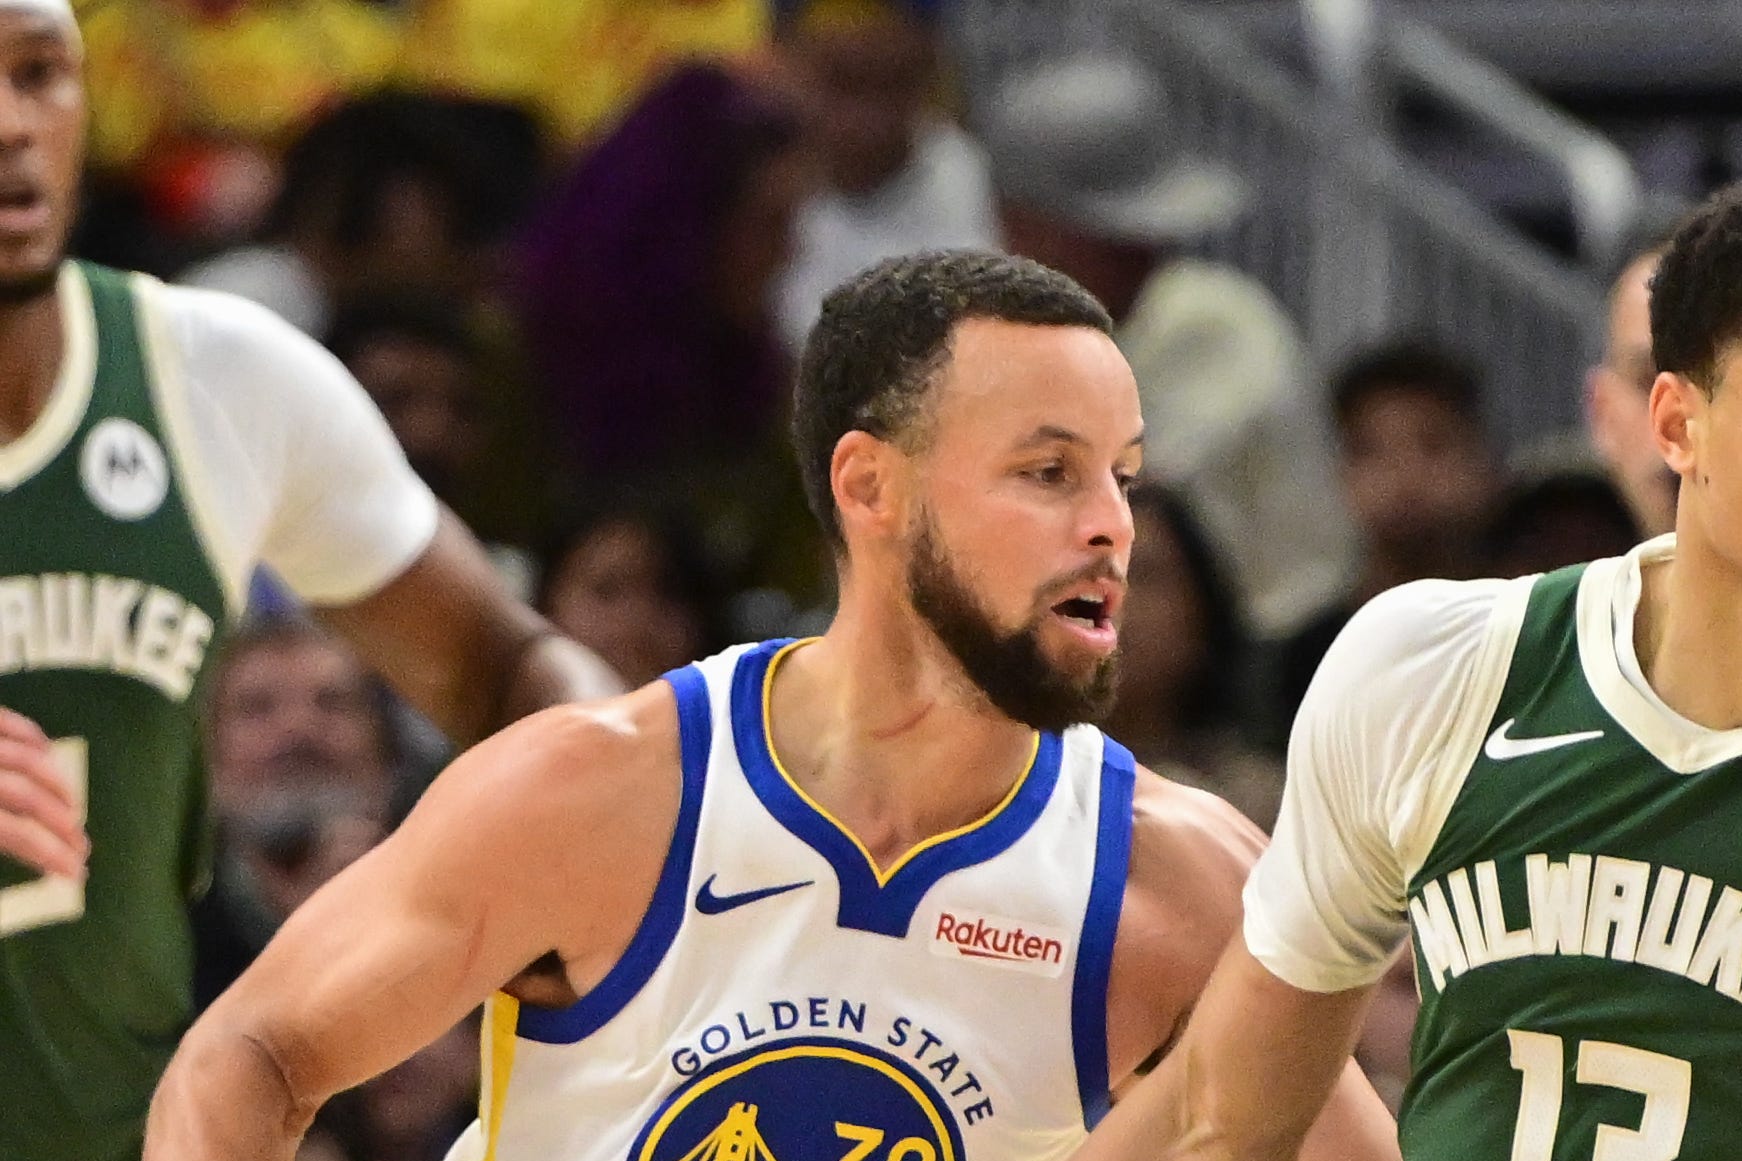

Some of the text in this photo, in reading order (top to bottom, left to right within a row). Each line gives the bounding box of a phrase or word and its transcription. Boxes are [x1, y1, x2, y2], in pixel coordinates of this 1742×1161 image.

[936, 913, 1062, 970] Rakuten
[671, 997, 994, 1127] GOLDEN STATE
